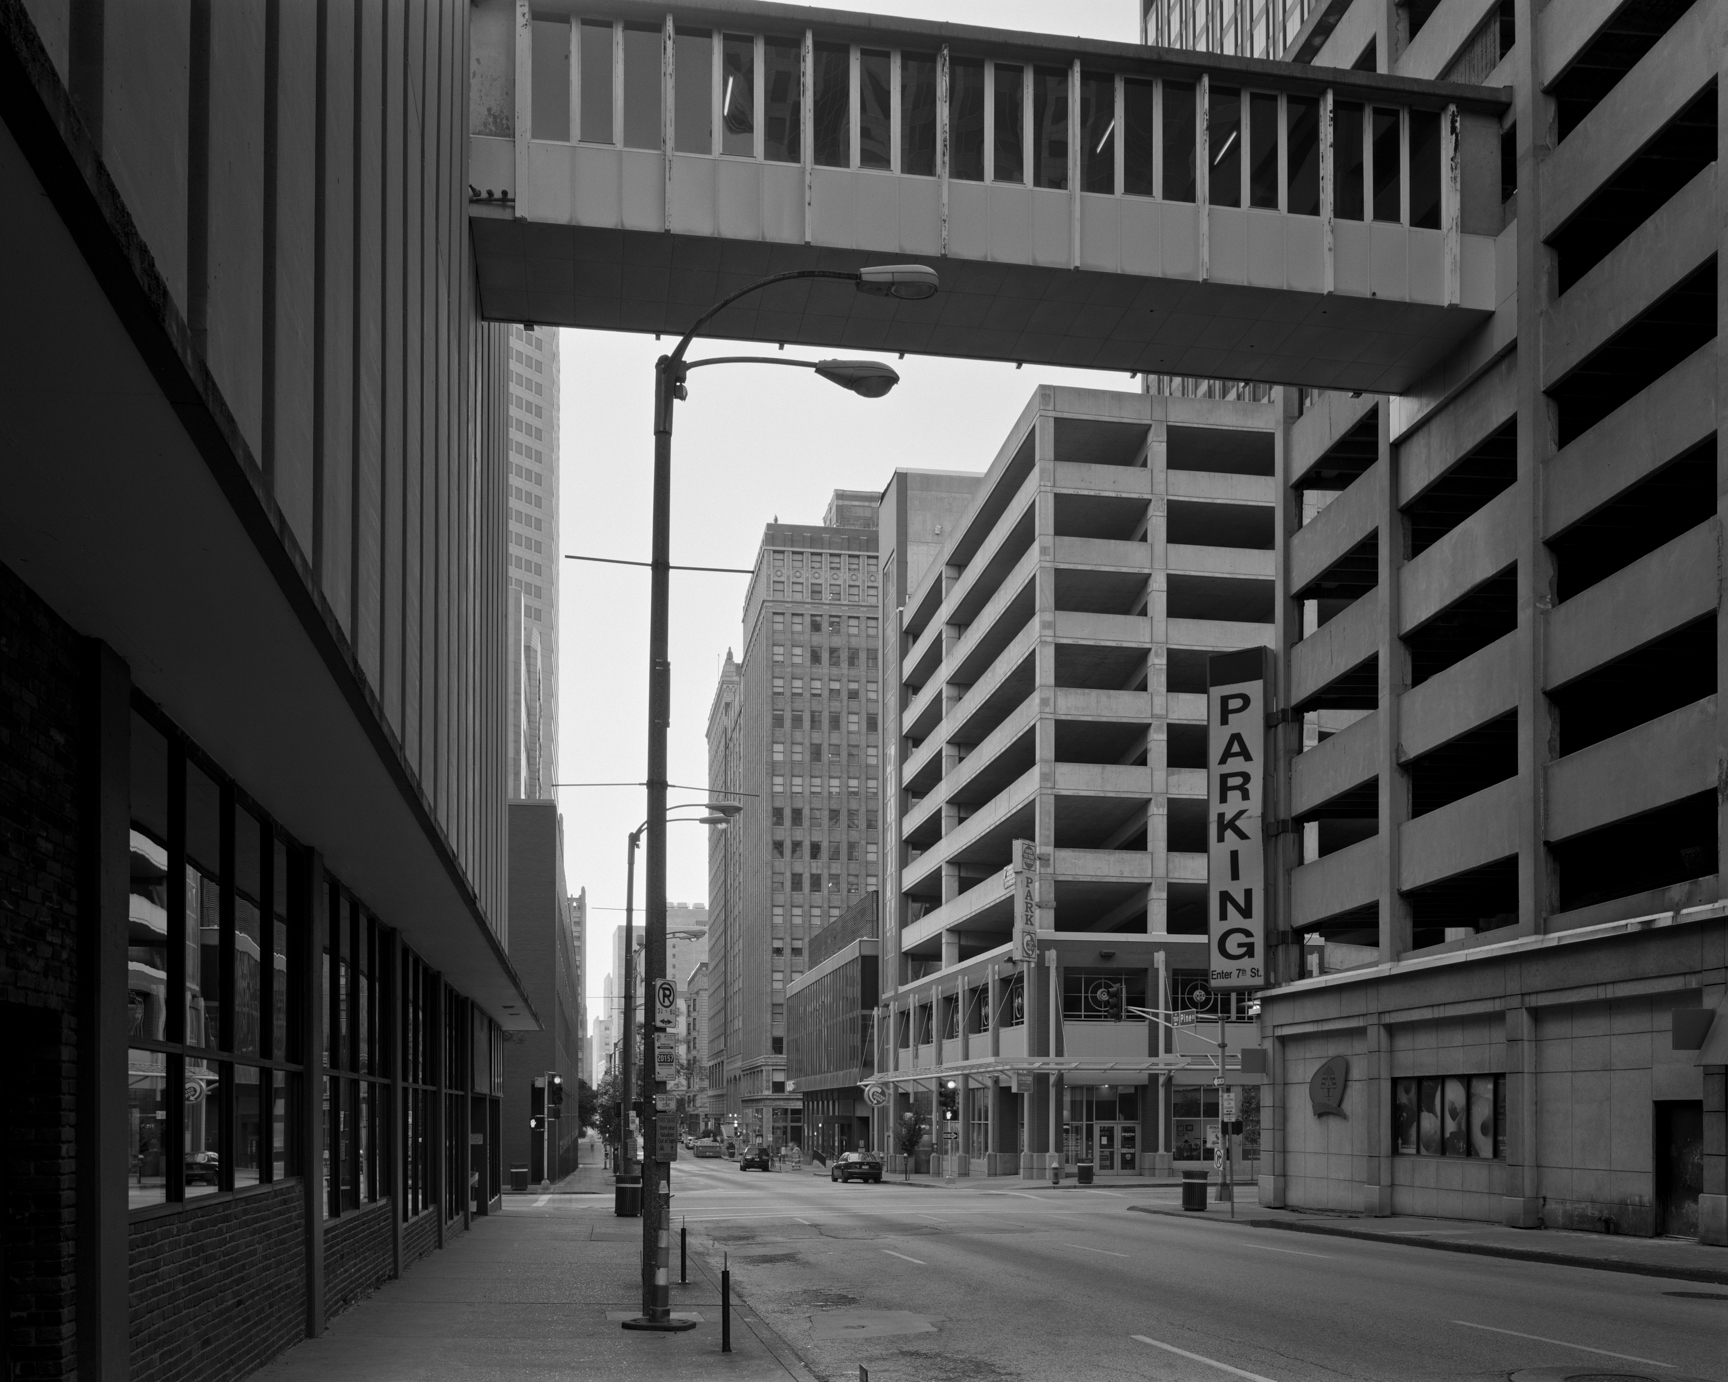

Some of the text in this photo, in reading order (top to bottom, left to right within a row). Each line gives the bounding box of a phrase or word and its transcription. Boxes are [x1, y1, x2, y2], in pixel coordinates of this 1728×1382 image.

[1216, 692, 1256, 961] PARKING
[1024, 876, 1034, 927] PARK
[1211, 967, 1262, 980] Enter 7th St.
[1180, 1013, 1192, 1023] Pine
[657, 1054, 674, 1062] 20157
